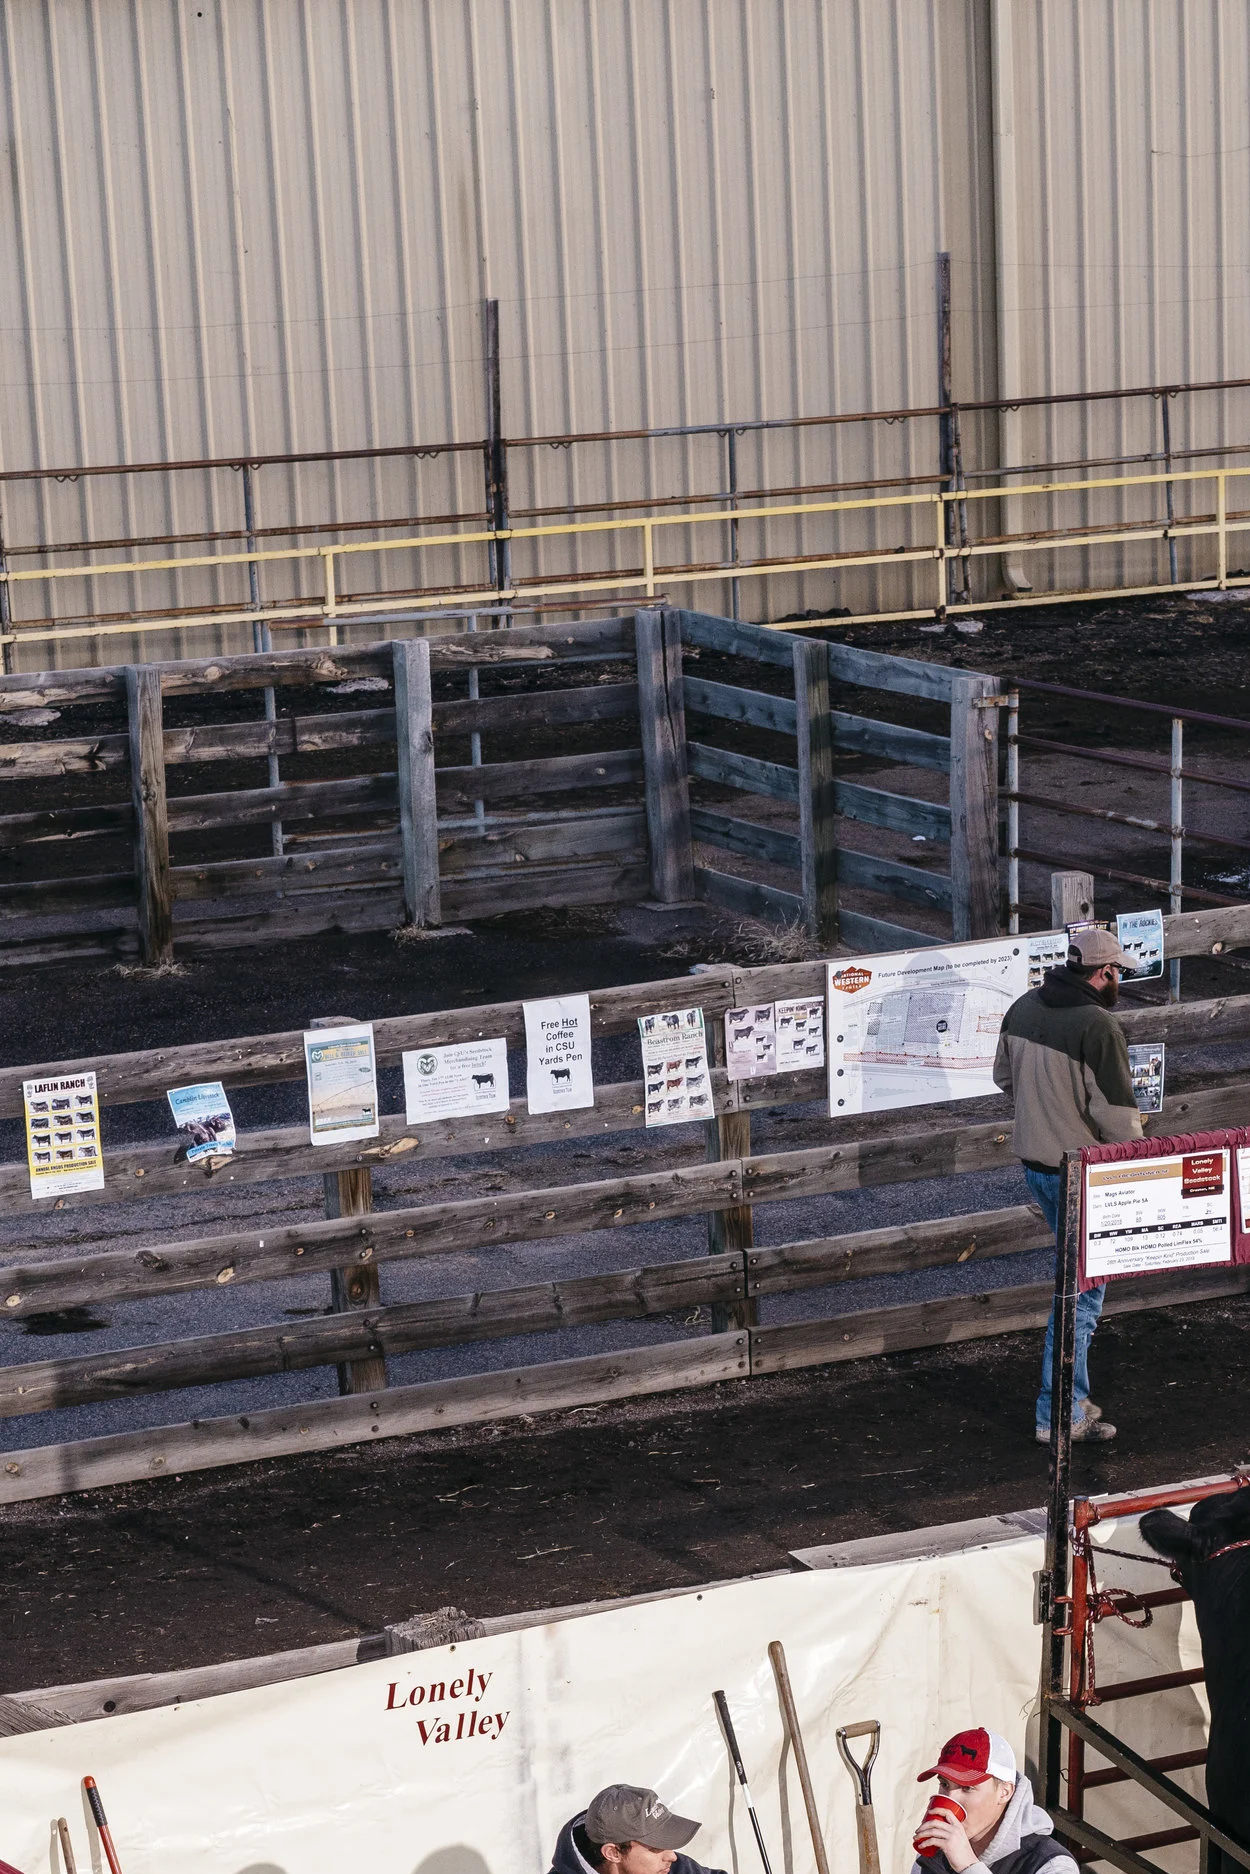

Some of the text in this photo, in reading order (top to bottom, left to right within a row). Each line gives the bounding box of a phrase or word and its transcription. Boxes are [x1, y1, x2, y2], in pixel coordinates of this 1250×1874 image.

[897, 966, 932, 976] Development
[962, 959, 989, 968] completed
[998, 955, 1012, 963] 2023)
[835, 976, 869, 986] WESTERN
[541, 1018, 578, 1030] Free Hot
[546, 1031, 574, 1040] Coffee
[682, 1030, 703, 1040] Ranch
[556, 1042, 575, 1051] CSU
[539, 1054, 582, 1065] Yards Pen
[34, 1078, 85, 1093] LAFLIN RANCH
[64, 1161, 87, 1169] PRODUCTION
[1191, 1158, 1213, 1166] Lonely
[1184, 1175, 1220, 1184] Seedstock
[1105, 1200, 1117, 1208] LVLS
[1118, 1256, 1144, 1264] Anniversary
[384, 1668, 493, 1711] Lonely
[416, 1711, 510, 1746] Valley
